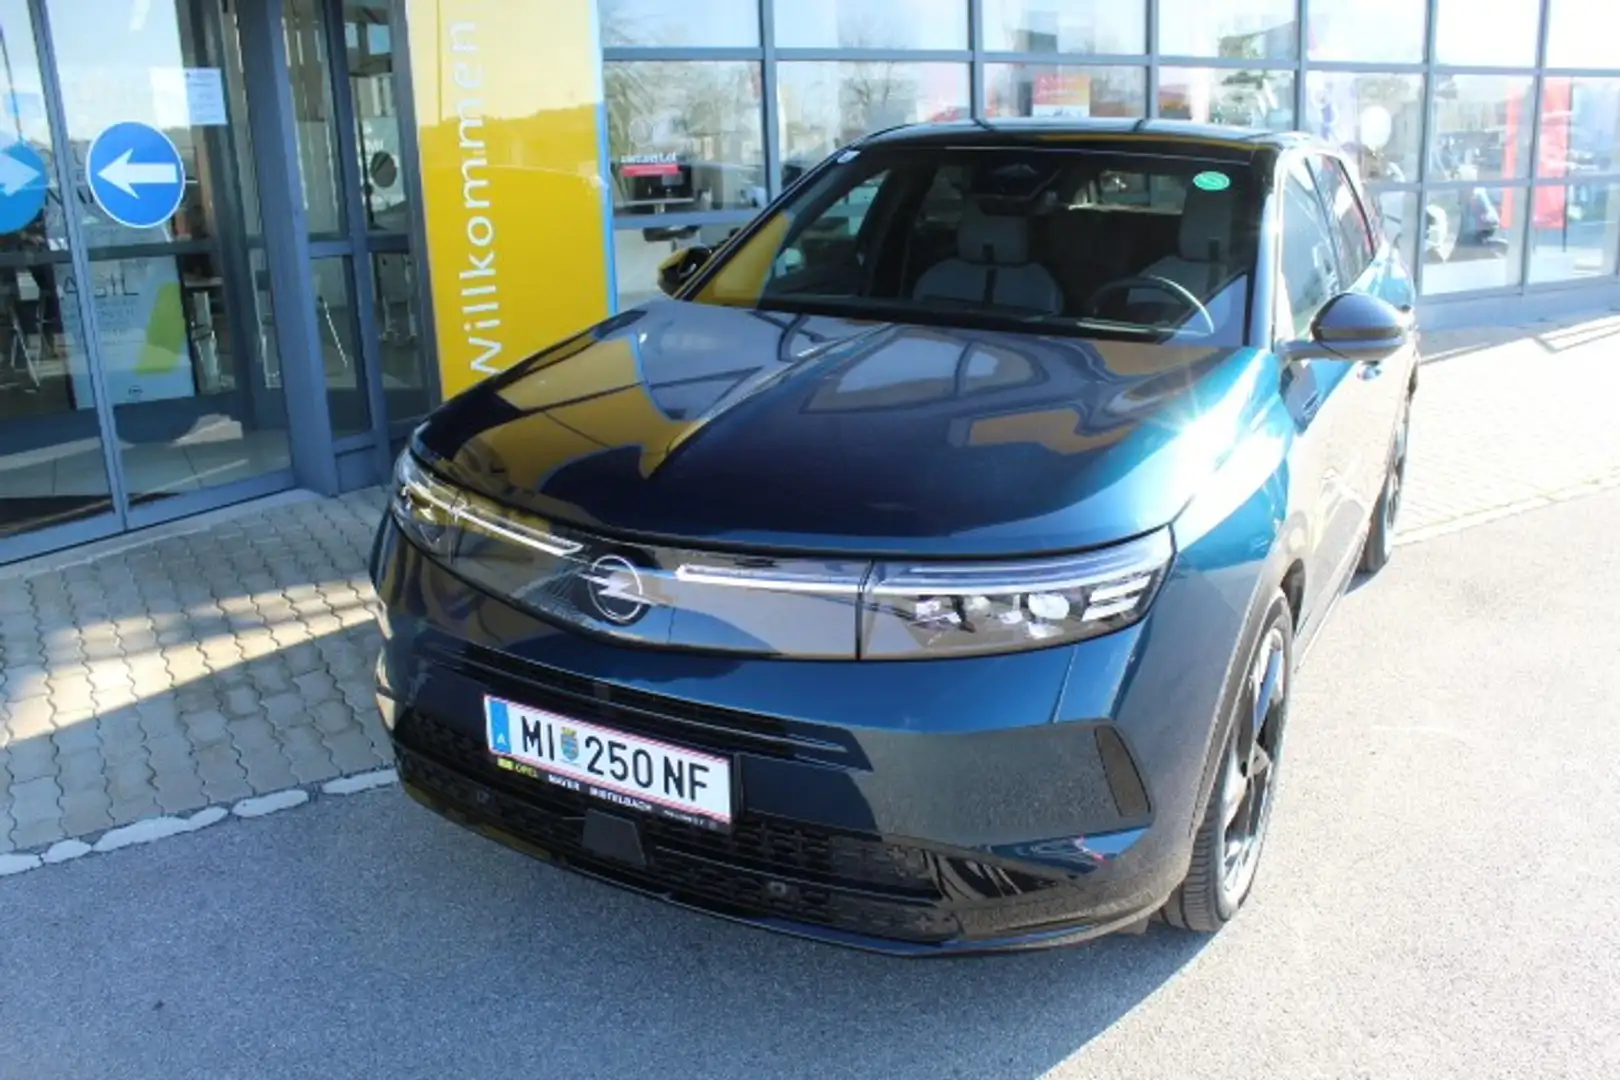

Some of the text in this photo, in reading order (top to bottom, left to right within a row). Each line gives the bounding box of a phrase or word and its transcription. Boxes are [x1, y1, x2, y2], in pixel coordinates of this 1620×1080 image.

[450, 20, 502, 375] Willkommen
[521, 715, 710, 801] MI 250 NF
